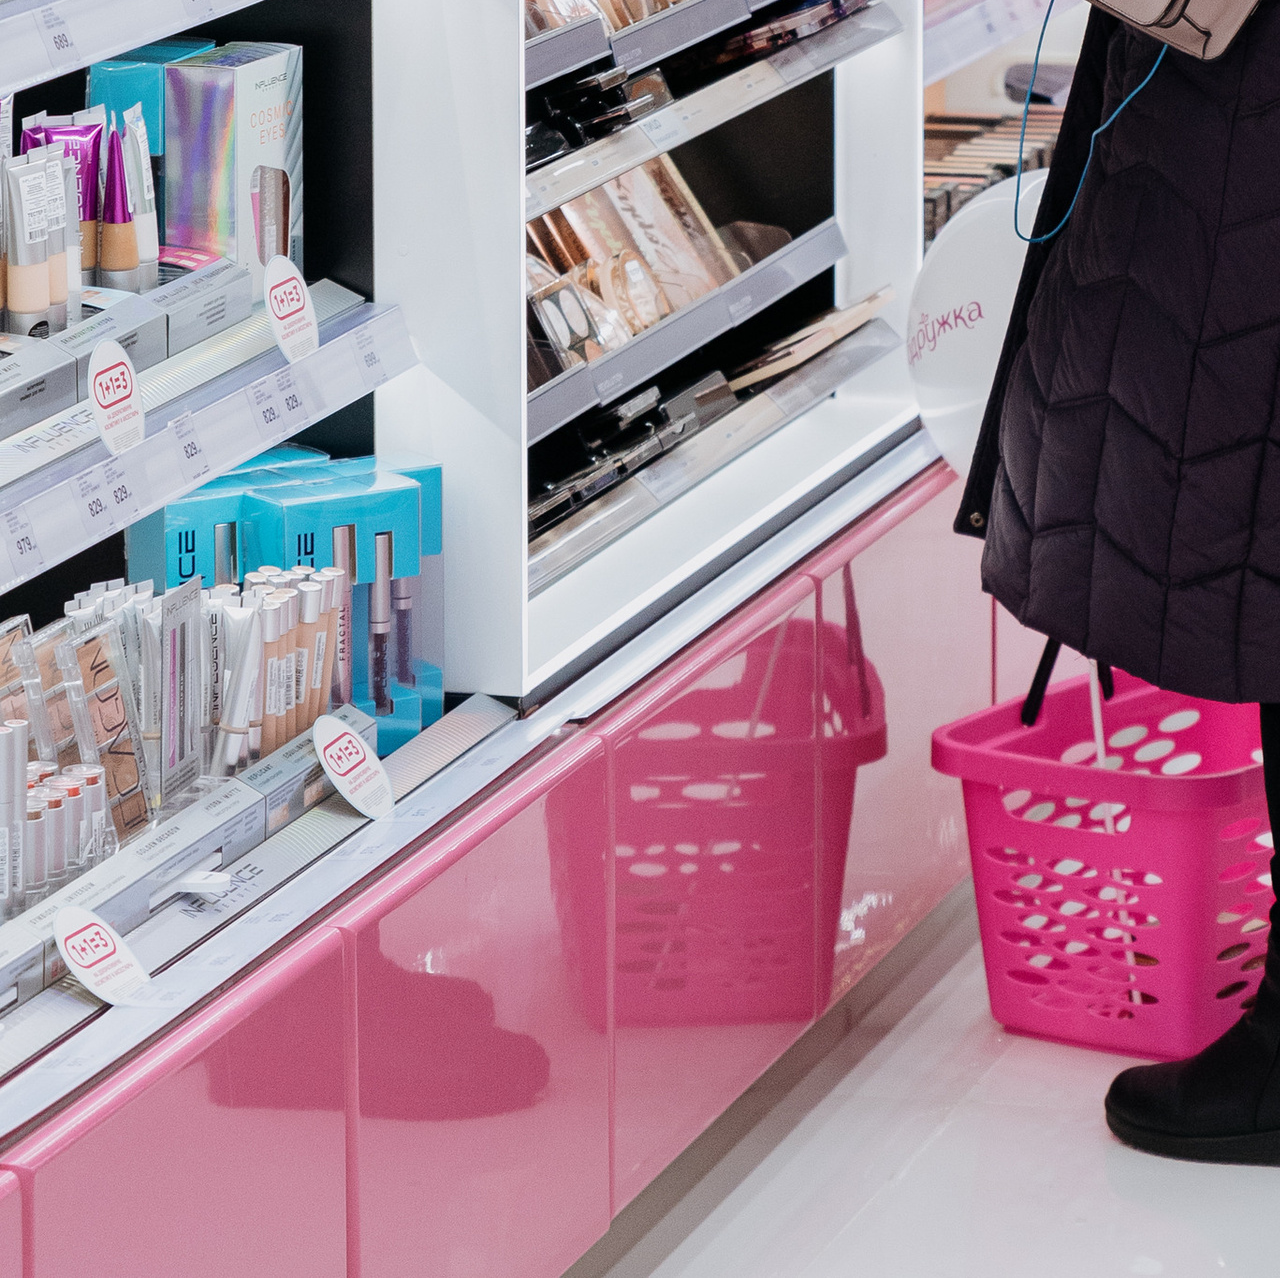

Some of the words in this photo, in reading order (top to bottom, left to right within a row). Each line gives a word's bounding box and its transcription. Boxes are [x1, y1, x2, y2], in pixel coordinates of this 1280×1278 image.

[53, 32, 69, 51] 689
[254, 71, 288, 91] INFLUENCE
[250, 99, 294, 130] COSMIC
[259, 120, 287, 145] EYES
[274, 285, 302, 313] 1+1=3
[906, 301, 985, 367] дружка
[98, 370, 129, 400] 1+1=3
[262, 406, 276, 425] 829
[285, 393, 299, 412] 829
[12, 408, 94, 454] INFLUENCE
[183, 440, 198, 460] 829
[88, 497, 103, 518] 829
[113, 484, 128, 505] 829
[16, 535, 32, 556] 979
[165, 589, 198, 615] INFLUENCE
[338, 606, 346, 662] FRACTAL
[329, 739, 361, 769] 1+1=3
[247, 763, 274, 782] REPLICANT
[203, 797, 221, 813] HYDRA
[221, 786, 242, 803] MATTE
[136, 838, 158, 856] GOLDEN
[158, 825, 182, 843] DECAGON
[213, 881, 259, 915] BEAUTY
[72, 930, 109, 961] 1+1=3
